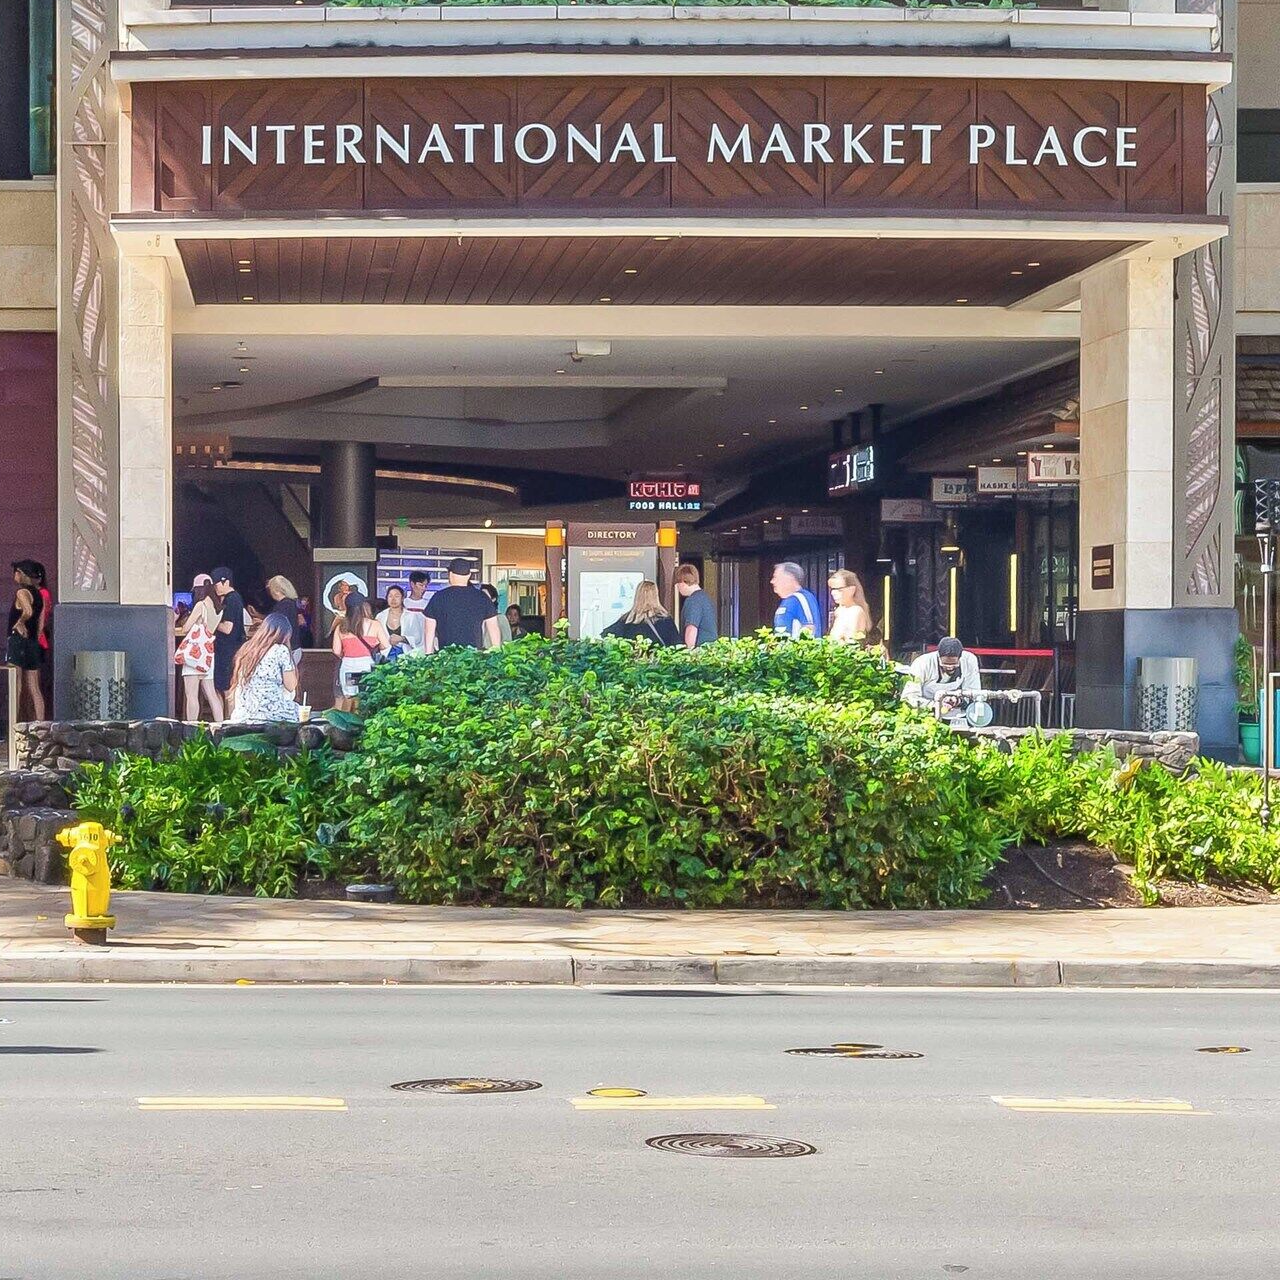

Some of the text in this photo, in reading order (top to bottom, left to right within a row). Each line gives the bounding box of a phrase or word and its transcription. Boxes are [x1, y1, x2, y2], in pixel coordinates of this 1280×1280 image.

[200, 123, 1139, 168] INTERNATIONAL MARKET PLACE
[630, 501, 655, 510] FOOD
[658, 501, 684, 510] HALL
[587, 530, 638, 539] DIRECTORY
